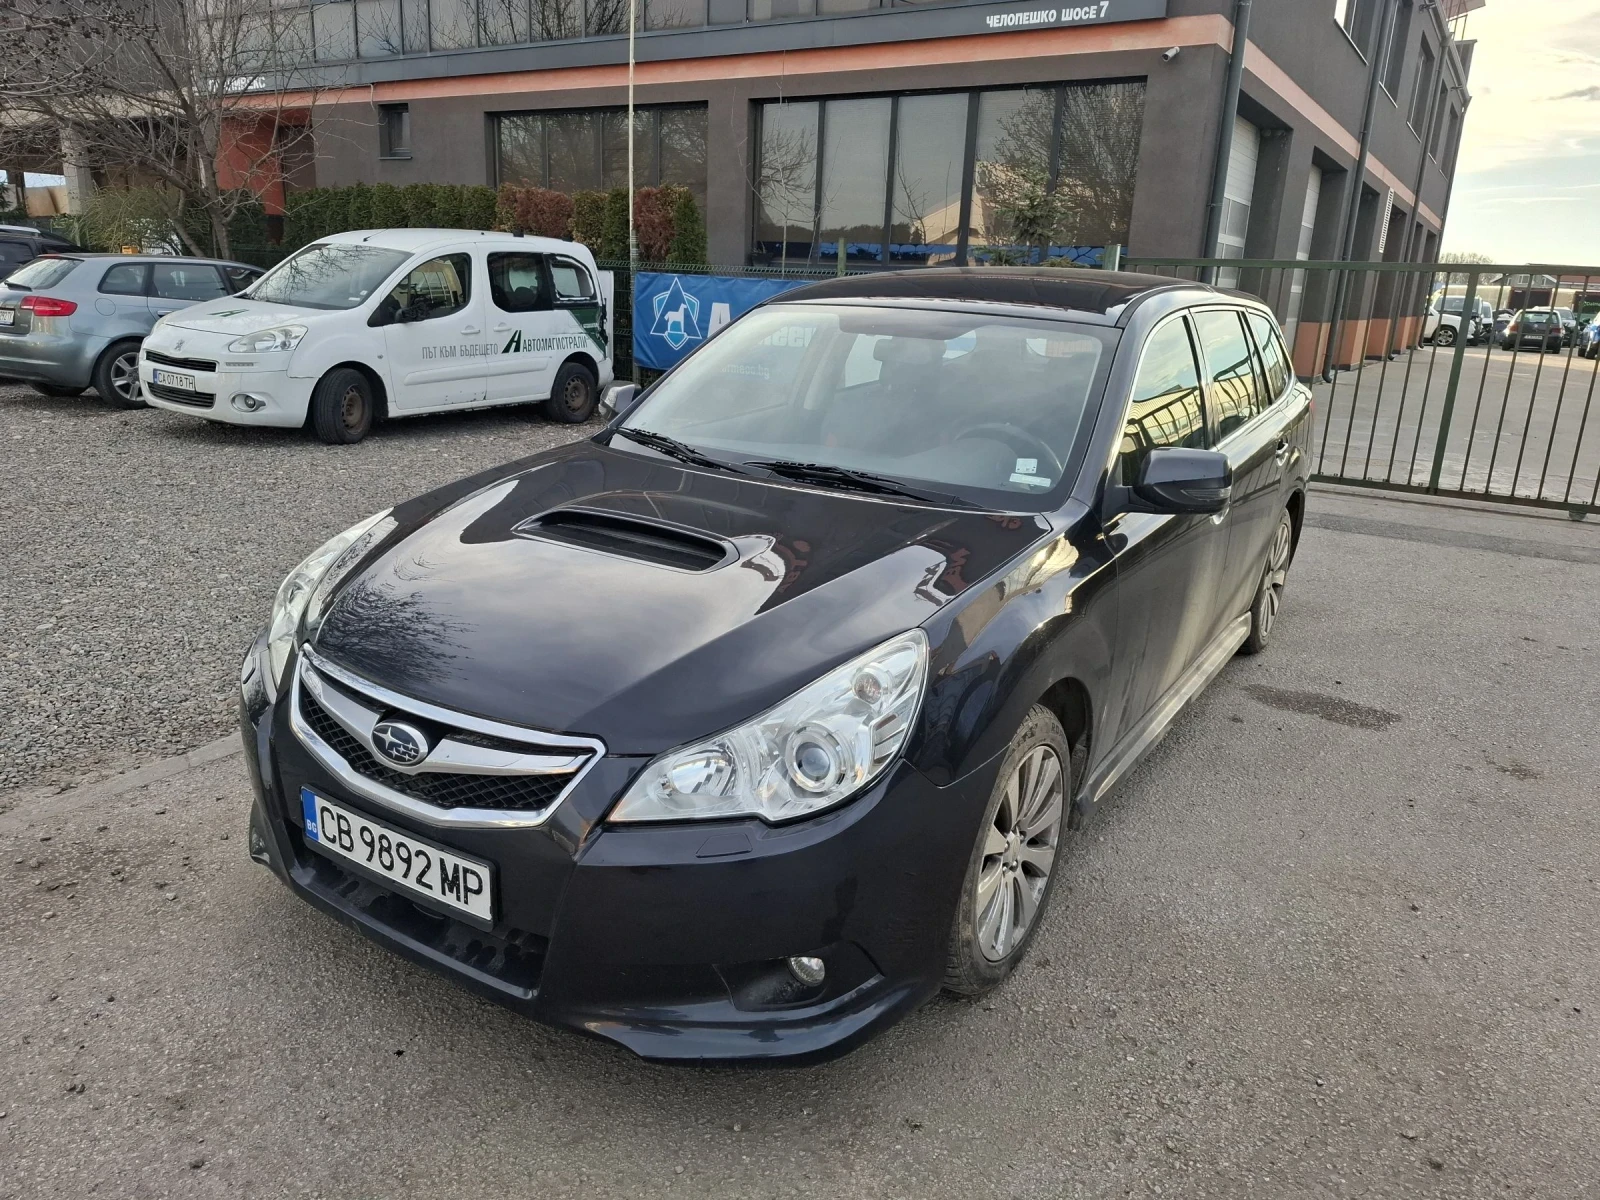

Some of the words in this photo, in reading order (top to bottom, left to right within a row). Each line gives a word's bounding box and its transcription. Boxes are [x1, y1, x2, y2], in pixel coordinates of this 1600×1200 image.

[986, 9, 1057, 28] ЧЕЛОПЕШКО
[1061, 5, 1097, 22] ШОСЕ
[1099, 1, 1110, 18] 7
[422, 346, 438, 360] ПЪТ
[440, 344, 457, 358] КЪМ
[460, 343, 499, 358] БЪДЕЩЕТО
[522, 334, 588, 353] АВТОМАГИСТРАЛИ
[306, 818, 318, 834] BG
[359, 825, 434, 891] 9892
